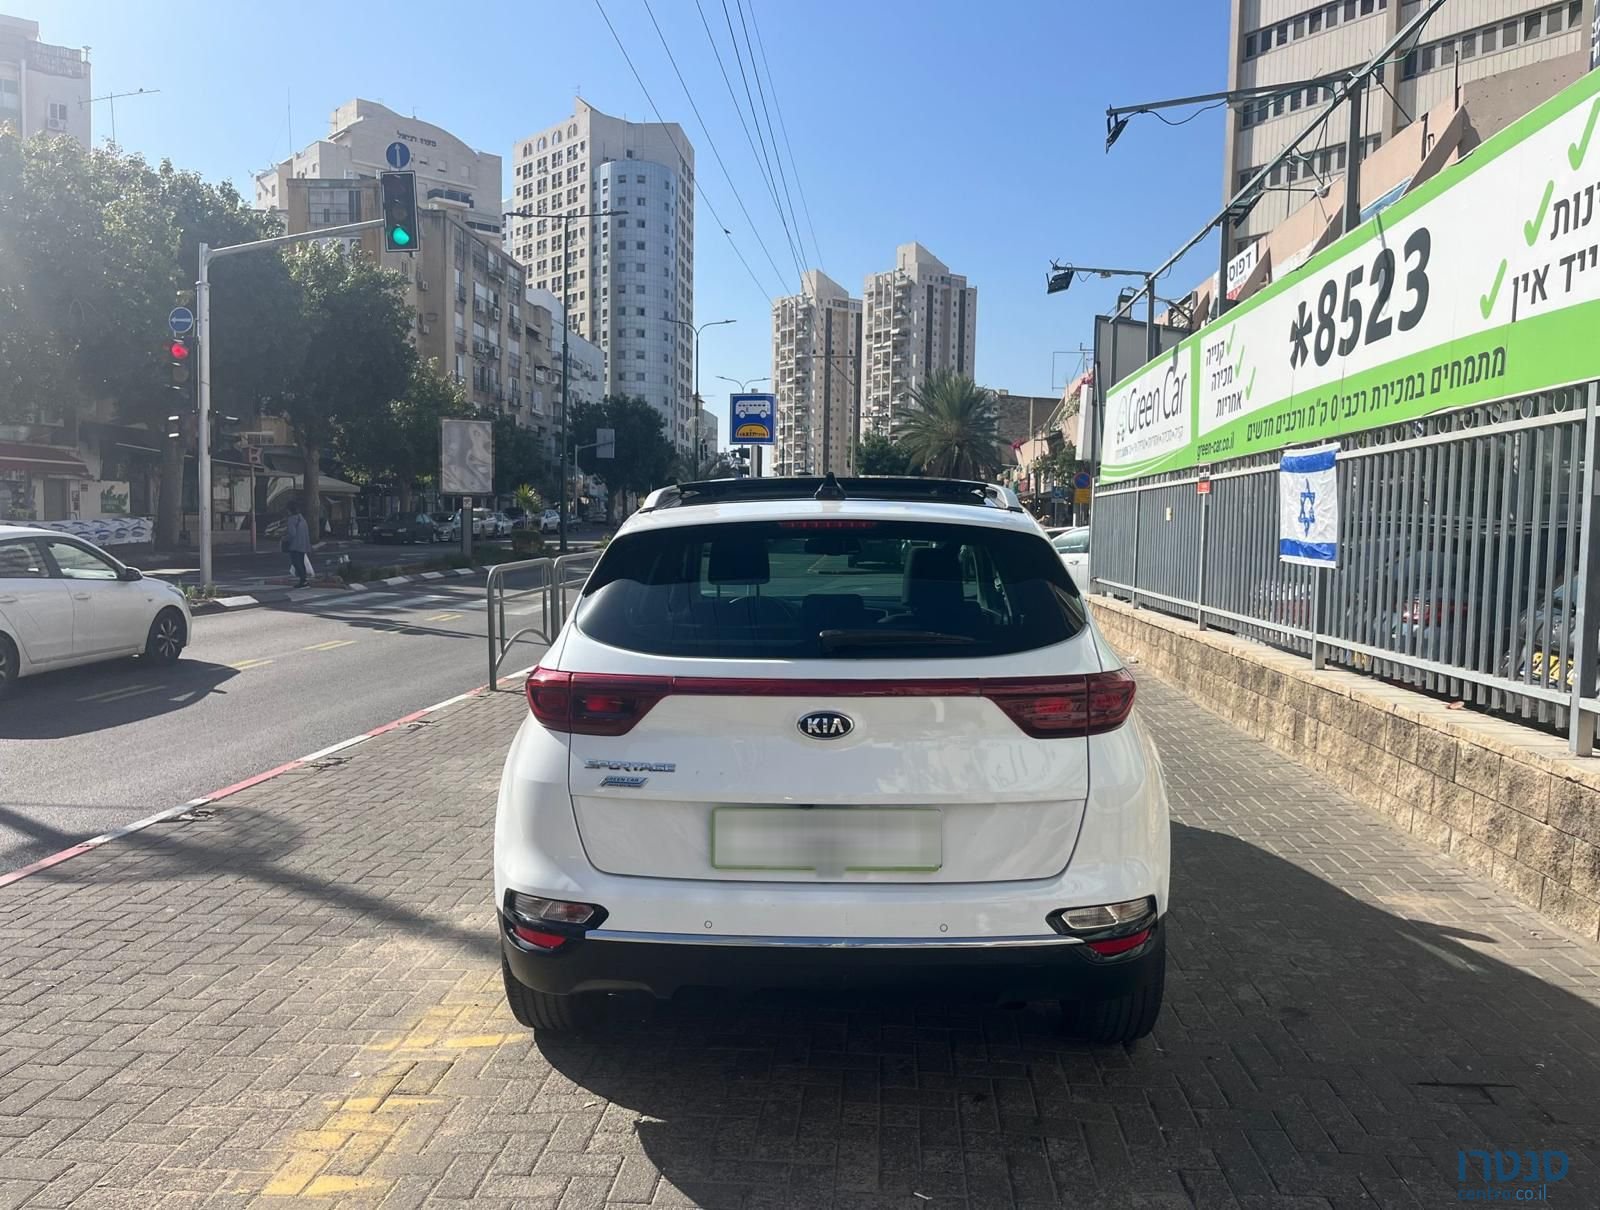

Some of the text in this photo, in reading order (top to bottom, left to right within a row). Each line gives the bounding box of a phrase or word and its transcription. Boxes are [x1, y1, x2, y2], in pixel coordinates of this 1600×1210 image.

[1550, 181, 1600, 241] נות
[1229, 252, 1252, 282] דפוס
[1512, 263, 1551, 323] אין
[1206, 340, 1225, 366] קנייה
[1211, 365, 1233, 391] מכירה
[1430, 346, 1506, 394] מתמחים
[1128, 366, 1188, 434] Green Car
[1216, 390, 1242, 418] אחריות
[1341, 390, 1367, 419] רכבי
[1369, 372, 1425, 412] במכירת
[1276, 408, 1305, 434] ורכבים
[1330, 394, 1338, 421] 0
[1247, 417, 1274, 442] חדשים
[1197, 432, 1235, 461] green-car.co.il
[807, 718, 845, 733] KIA
